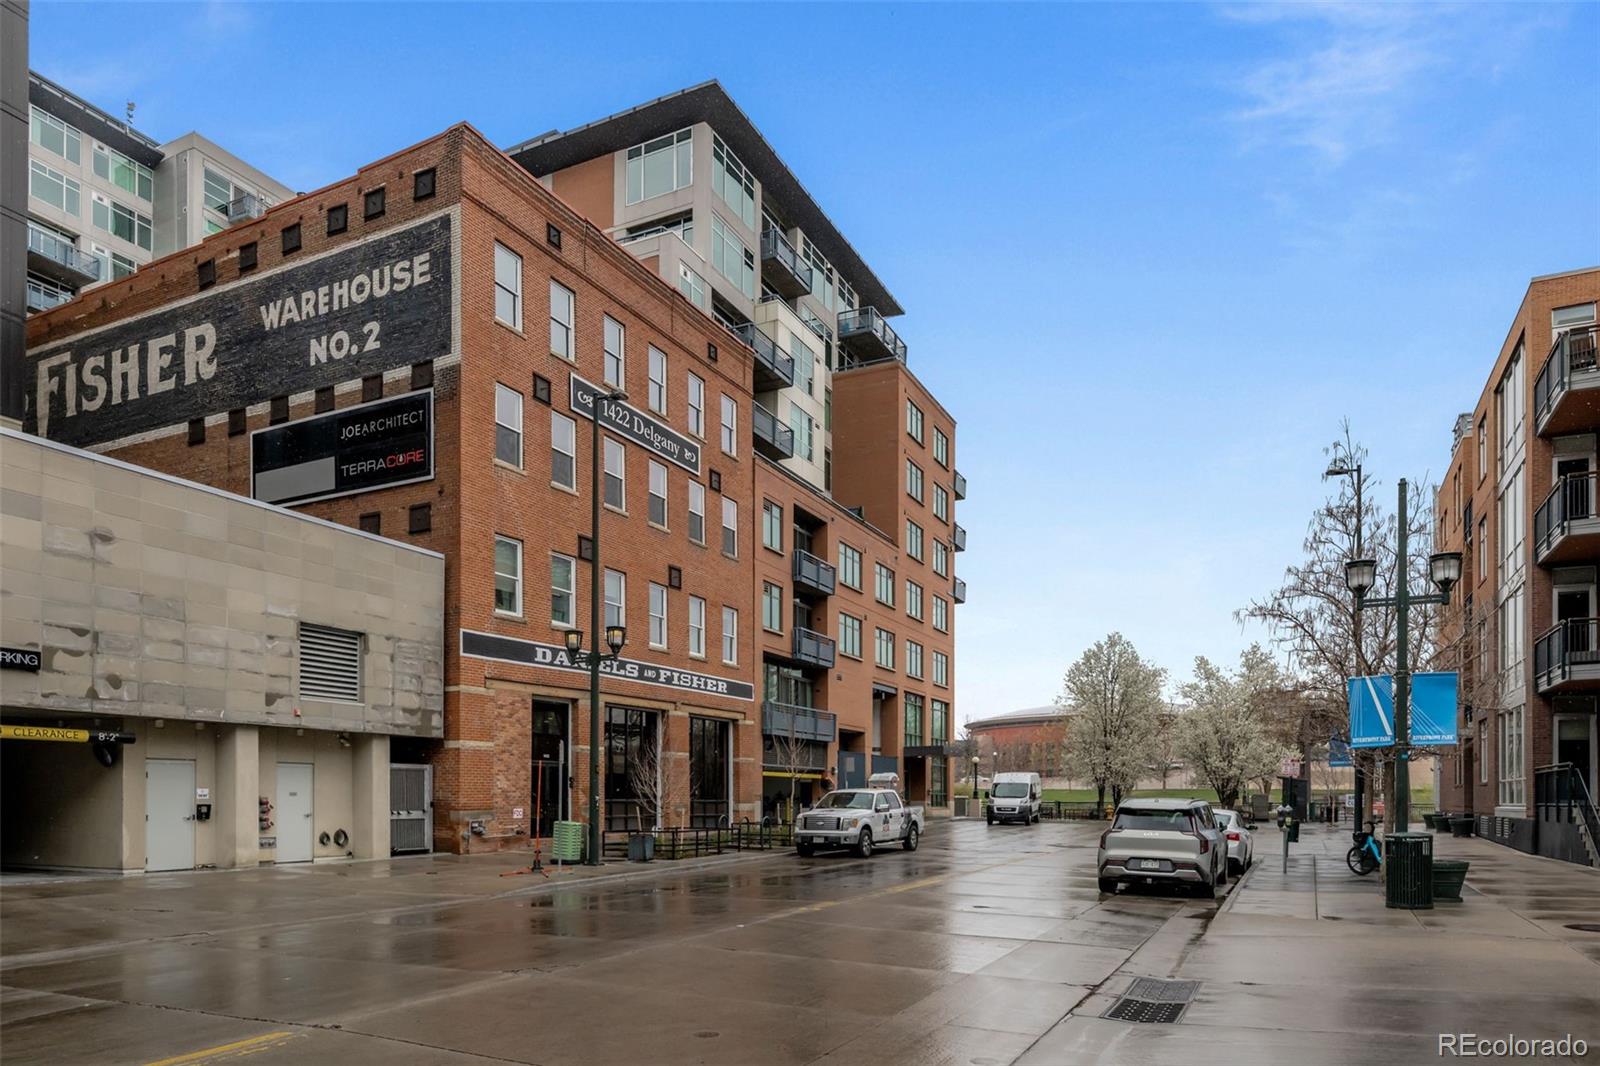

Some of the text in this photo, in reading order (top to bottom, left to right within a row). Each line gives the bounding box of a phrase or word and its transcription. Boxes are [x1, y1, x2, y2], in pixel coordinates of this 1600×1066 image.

[259, 252, 431, 331] WAREHOUSE
[36, 322, 218, 438] FISHER
[340, 410, 425, 440] JOEARCHITECT
[602, 400, 680, 459] 1422 Delgany
[340, 449, 425, 477] TERRACORE
[534, 646, 728, 693] DAELS AND FISHER
[13, 727, 79, 740] CLEARANCE
